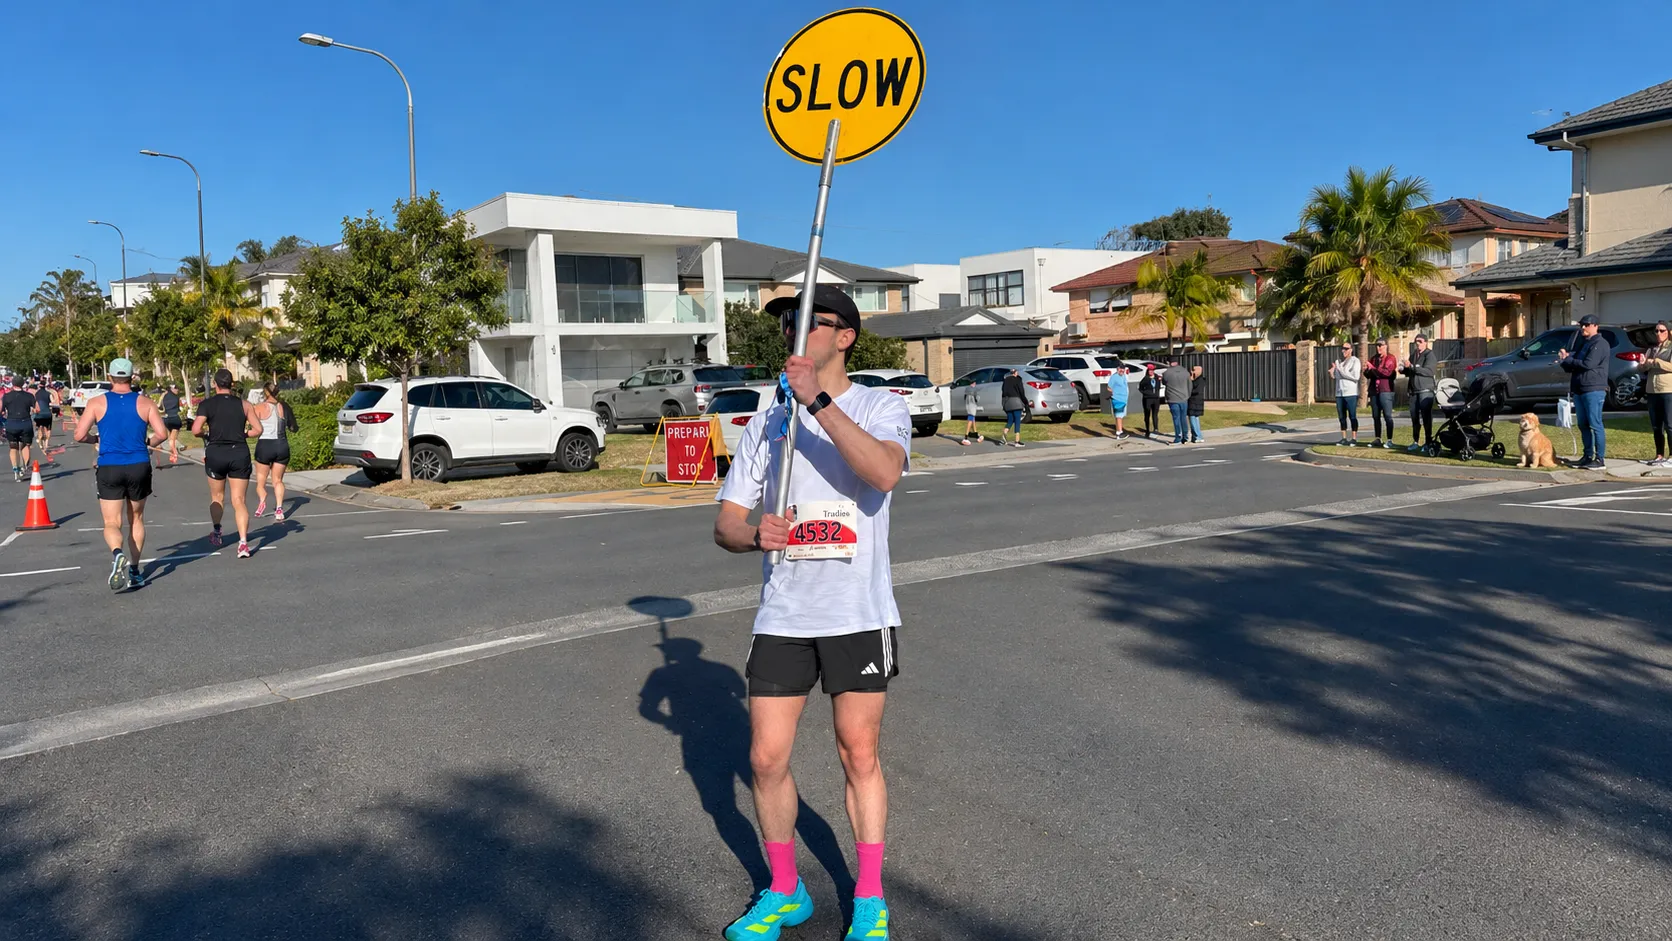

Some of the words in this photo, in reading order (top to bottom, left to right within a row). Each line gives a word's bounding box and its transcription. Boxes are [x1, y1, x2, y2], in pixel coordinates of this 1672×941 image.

[776, 57, 913, 113] SLOW
[684, 445, 696, 457] TO
[794, 521, 842, 543] 4532
